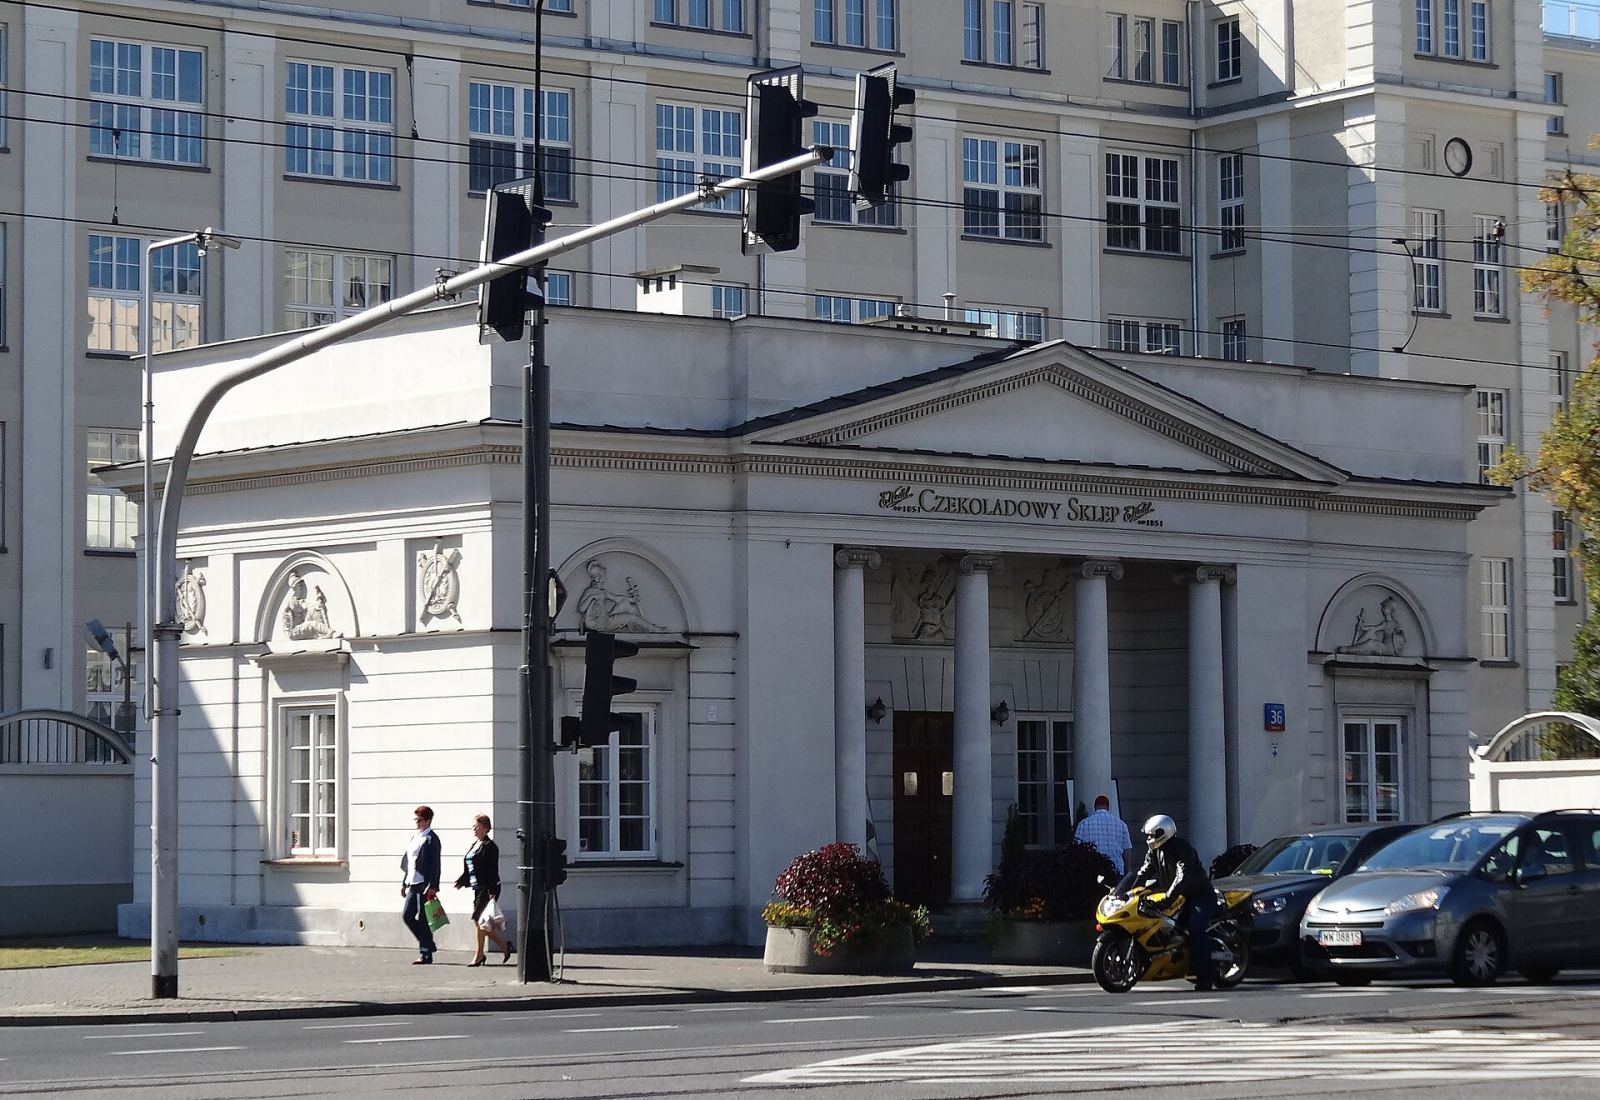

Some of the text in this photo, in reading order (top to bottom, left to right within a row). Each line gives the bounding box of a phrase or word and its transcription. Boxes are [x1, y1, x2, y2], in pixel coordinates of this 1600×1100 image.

[919, 488, 1120, 523] CZEKOLADOWY SKLEP
[1270, 710, 1282, 724] 36
